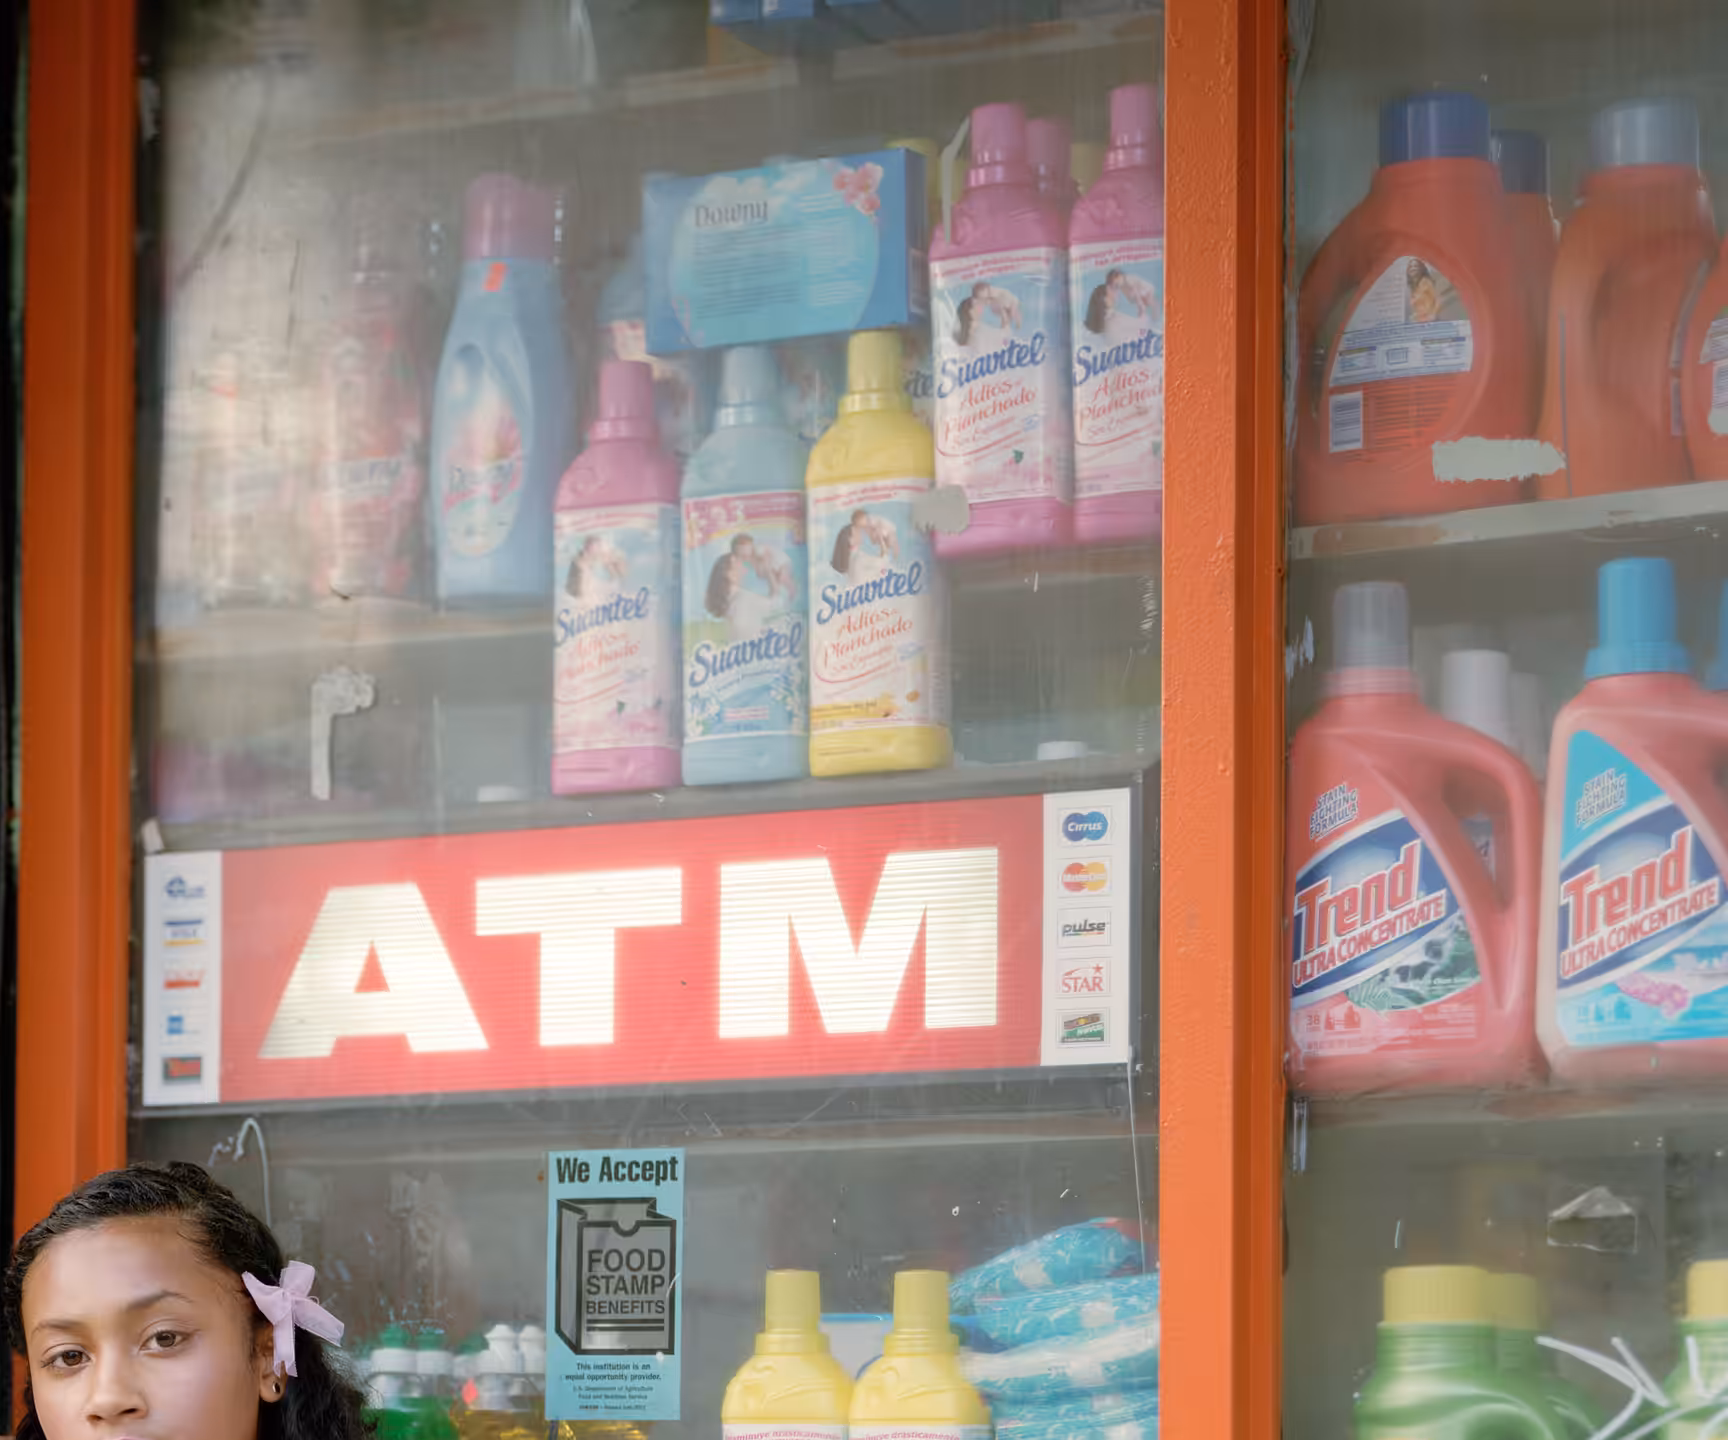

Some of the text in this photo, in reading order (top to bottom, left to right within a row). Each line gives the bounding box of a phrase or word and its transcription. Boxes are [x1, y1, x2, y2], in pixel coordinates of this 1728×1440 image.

[694, 201, 769, 227] Downy
[936, 331, 1046, 399] Suavitel
[1073, 329, 1163, 387] Suavite
[944, 388, 1038, 442] Planchado
[817, 560, 923, 625] Suavitel
[556, 586, 650, 648] Suavitel
[689, 620, 802, 688] Suavitel
[824, 616, 913, 669] Planchado
[1310, 788, 1358, 826] FIGHTING
[1317, 783, 1347, 809] STAIN
[1067, 820, 1104, 832] Cirrus
[1310, 803, 1358, 841] FORMULA
[1295, 839, 1421, 955] Trend
[1561, 826, 1693, 947] Trend
[1062, 919, 1106, 937] pulse
[1292, 889, 1447, 989] ULTRA CONCENTRATE
[1561, 876, 1721, 980] ULTRA CONCENTRATE
[257, 845, 998, 1059] ATM
[1062, 975, 1104, 993] STAR
[556, 1156, 679, 1186] We Accept
[587, 1249, 666, 1273] FOOD
[586, 1274, 666, 1296] STAMP
[586, 1300, 666, 1315] BENEFITS
[565, 1373, 662, 1382] equal opportunity provider.
[576, 1362, 591, 1370] This
[593, 1362, 631, 1370] institution
[632, 1362, 639, 1370] is
